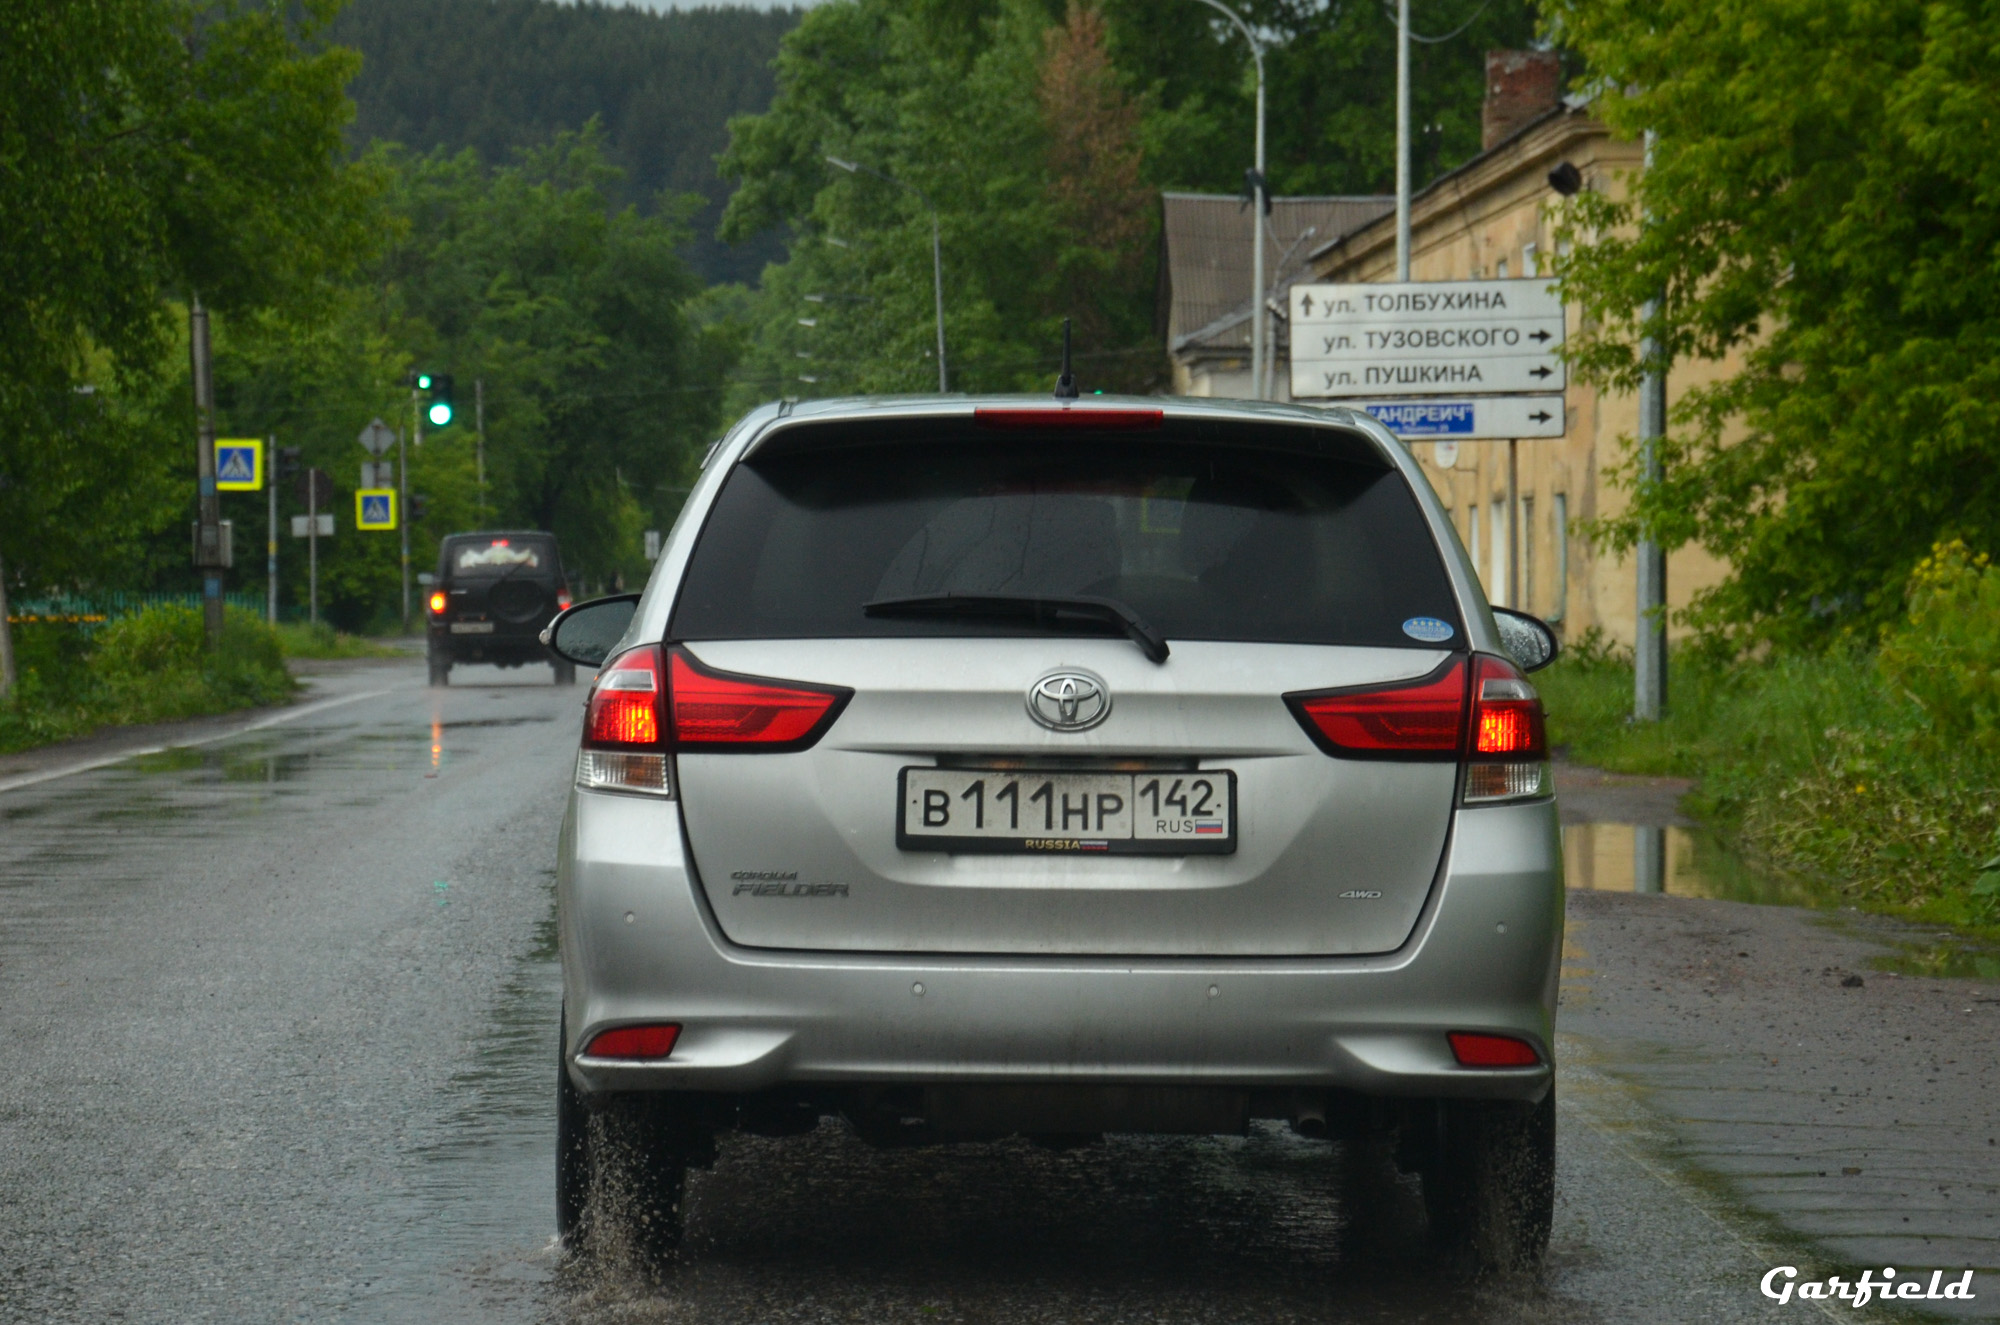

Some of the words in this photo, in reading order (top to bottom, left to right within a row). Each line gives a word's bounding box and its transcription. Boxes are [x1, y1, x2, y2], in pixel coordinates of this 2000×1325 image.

[1323, 299, 1356, 318] ул.
[1364, 291, 1507, 312] ТОЛБУХИНА
[1323, 336, 1356, 355] ул.
[1364, 328, 1520, 349] ТУЗОВСКОГО
[1324, 372, 1357, 390] ул.
[1365, 364, 1483, 385] ПУШКИНА
[1139, 779, 1214, 817] 142
[1156, 819, 1193, 834] RUS
[1025, 839, 1080, 850] RUSSIA
[732, 883, 849, 897] FIELDER
[1338, 890, 1382, 899] 4WD
